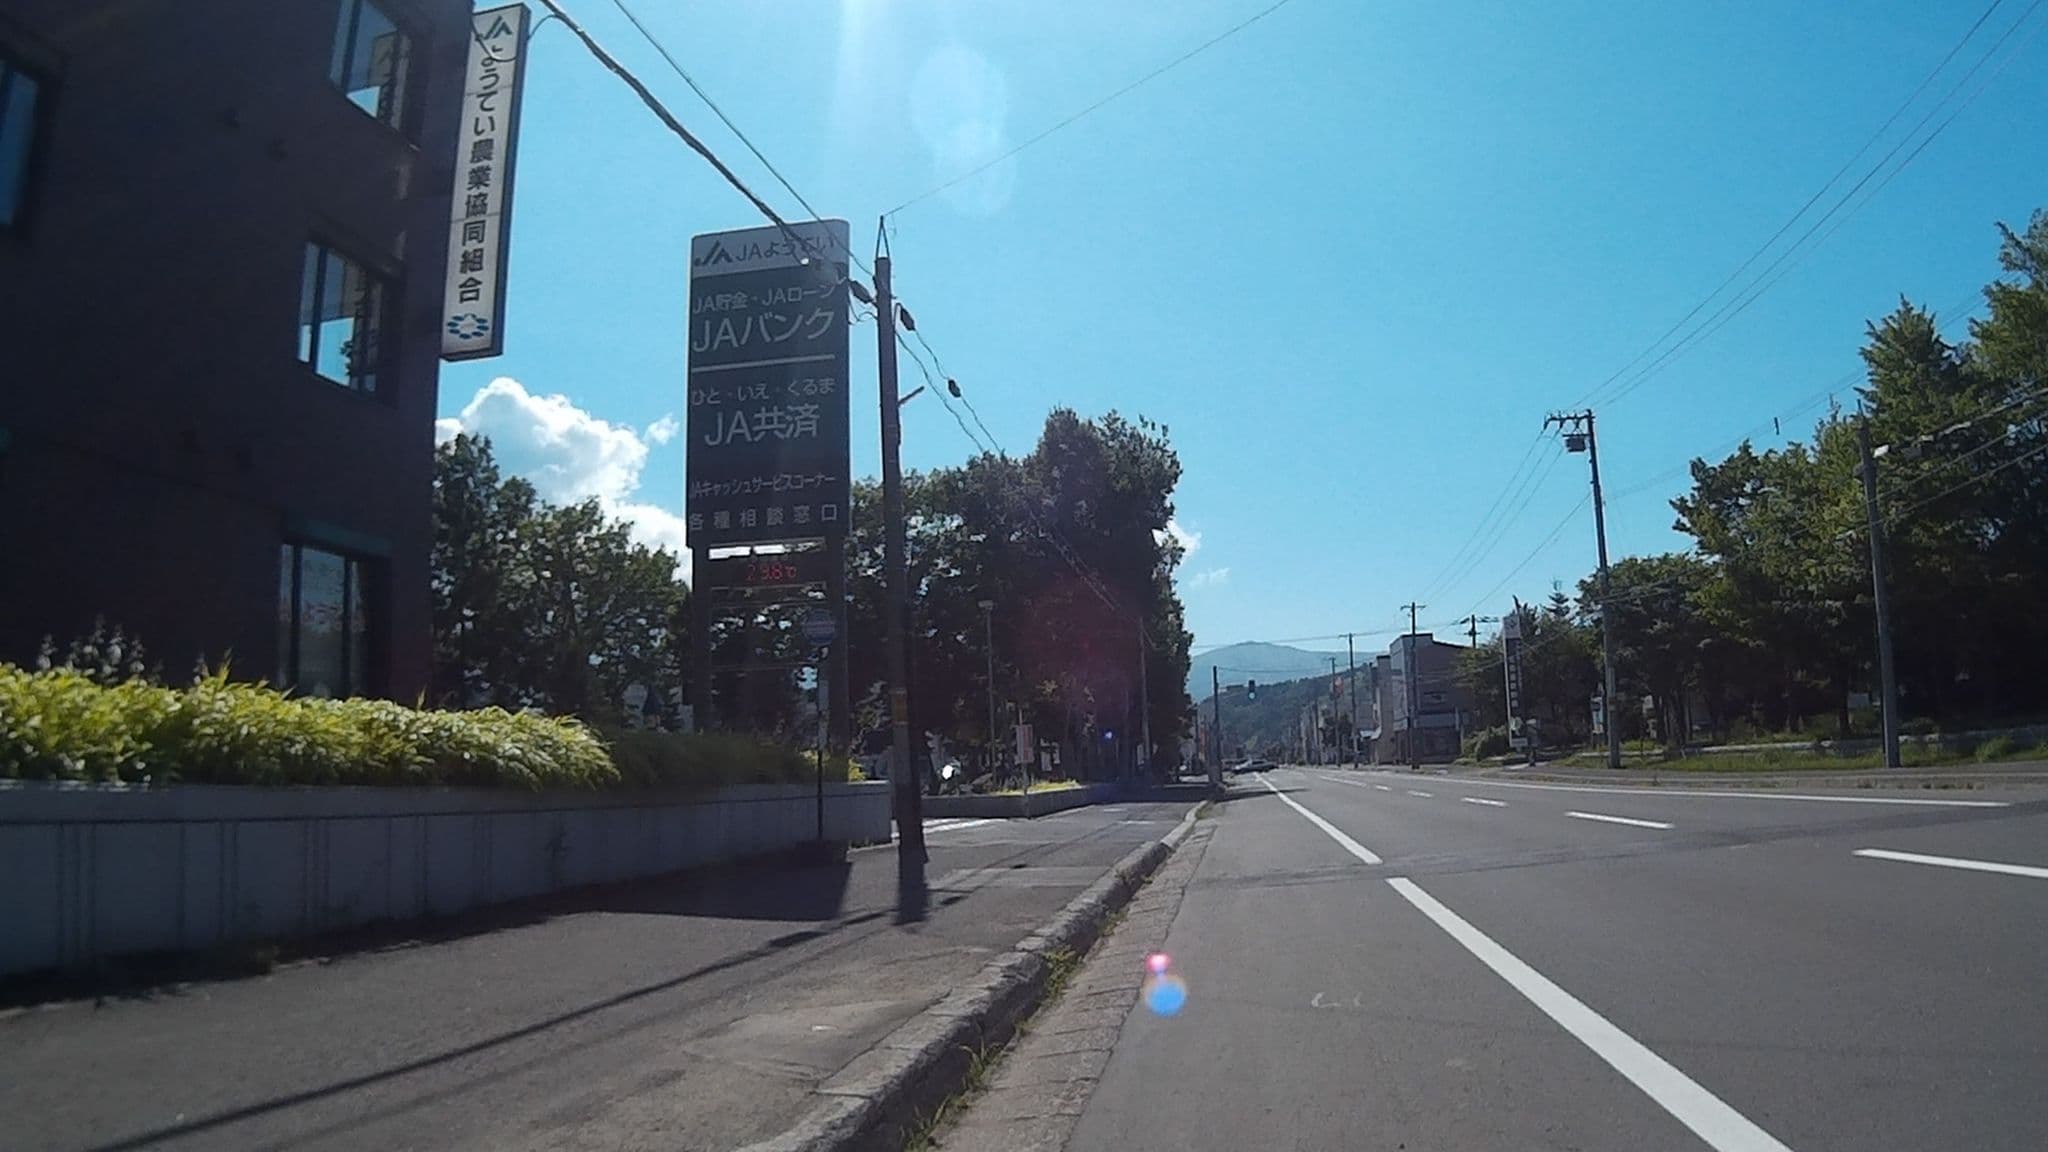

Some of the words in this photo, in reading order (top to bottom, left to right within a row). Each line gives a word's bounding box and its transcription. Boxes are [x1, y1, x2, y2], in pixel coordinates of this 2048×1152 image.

[459, 45, 501, 304] ようてい農業協同組合
[693, 307, 834, 352] JAバンク
[704, 403, 820, 446] JA共済
